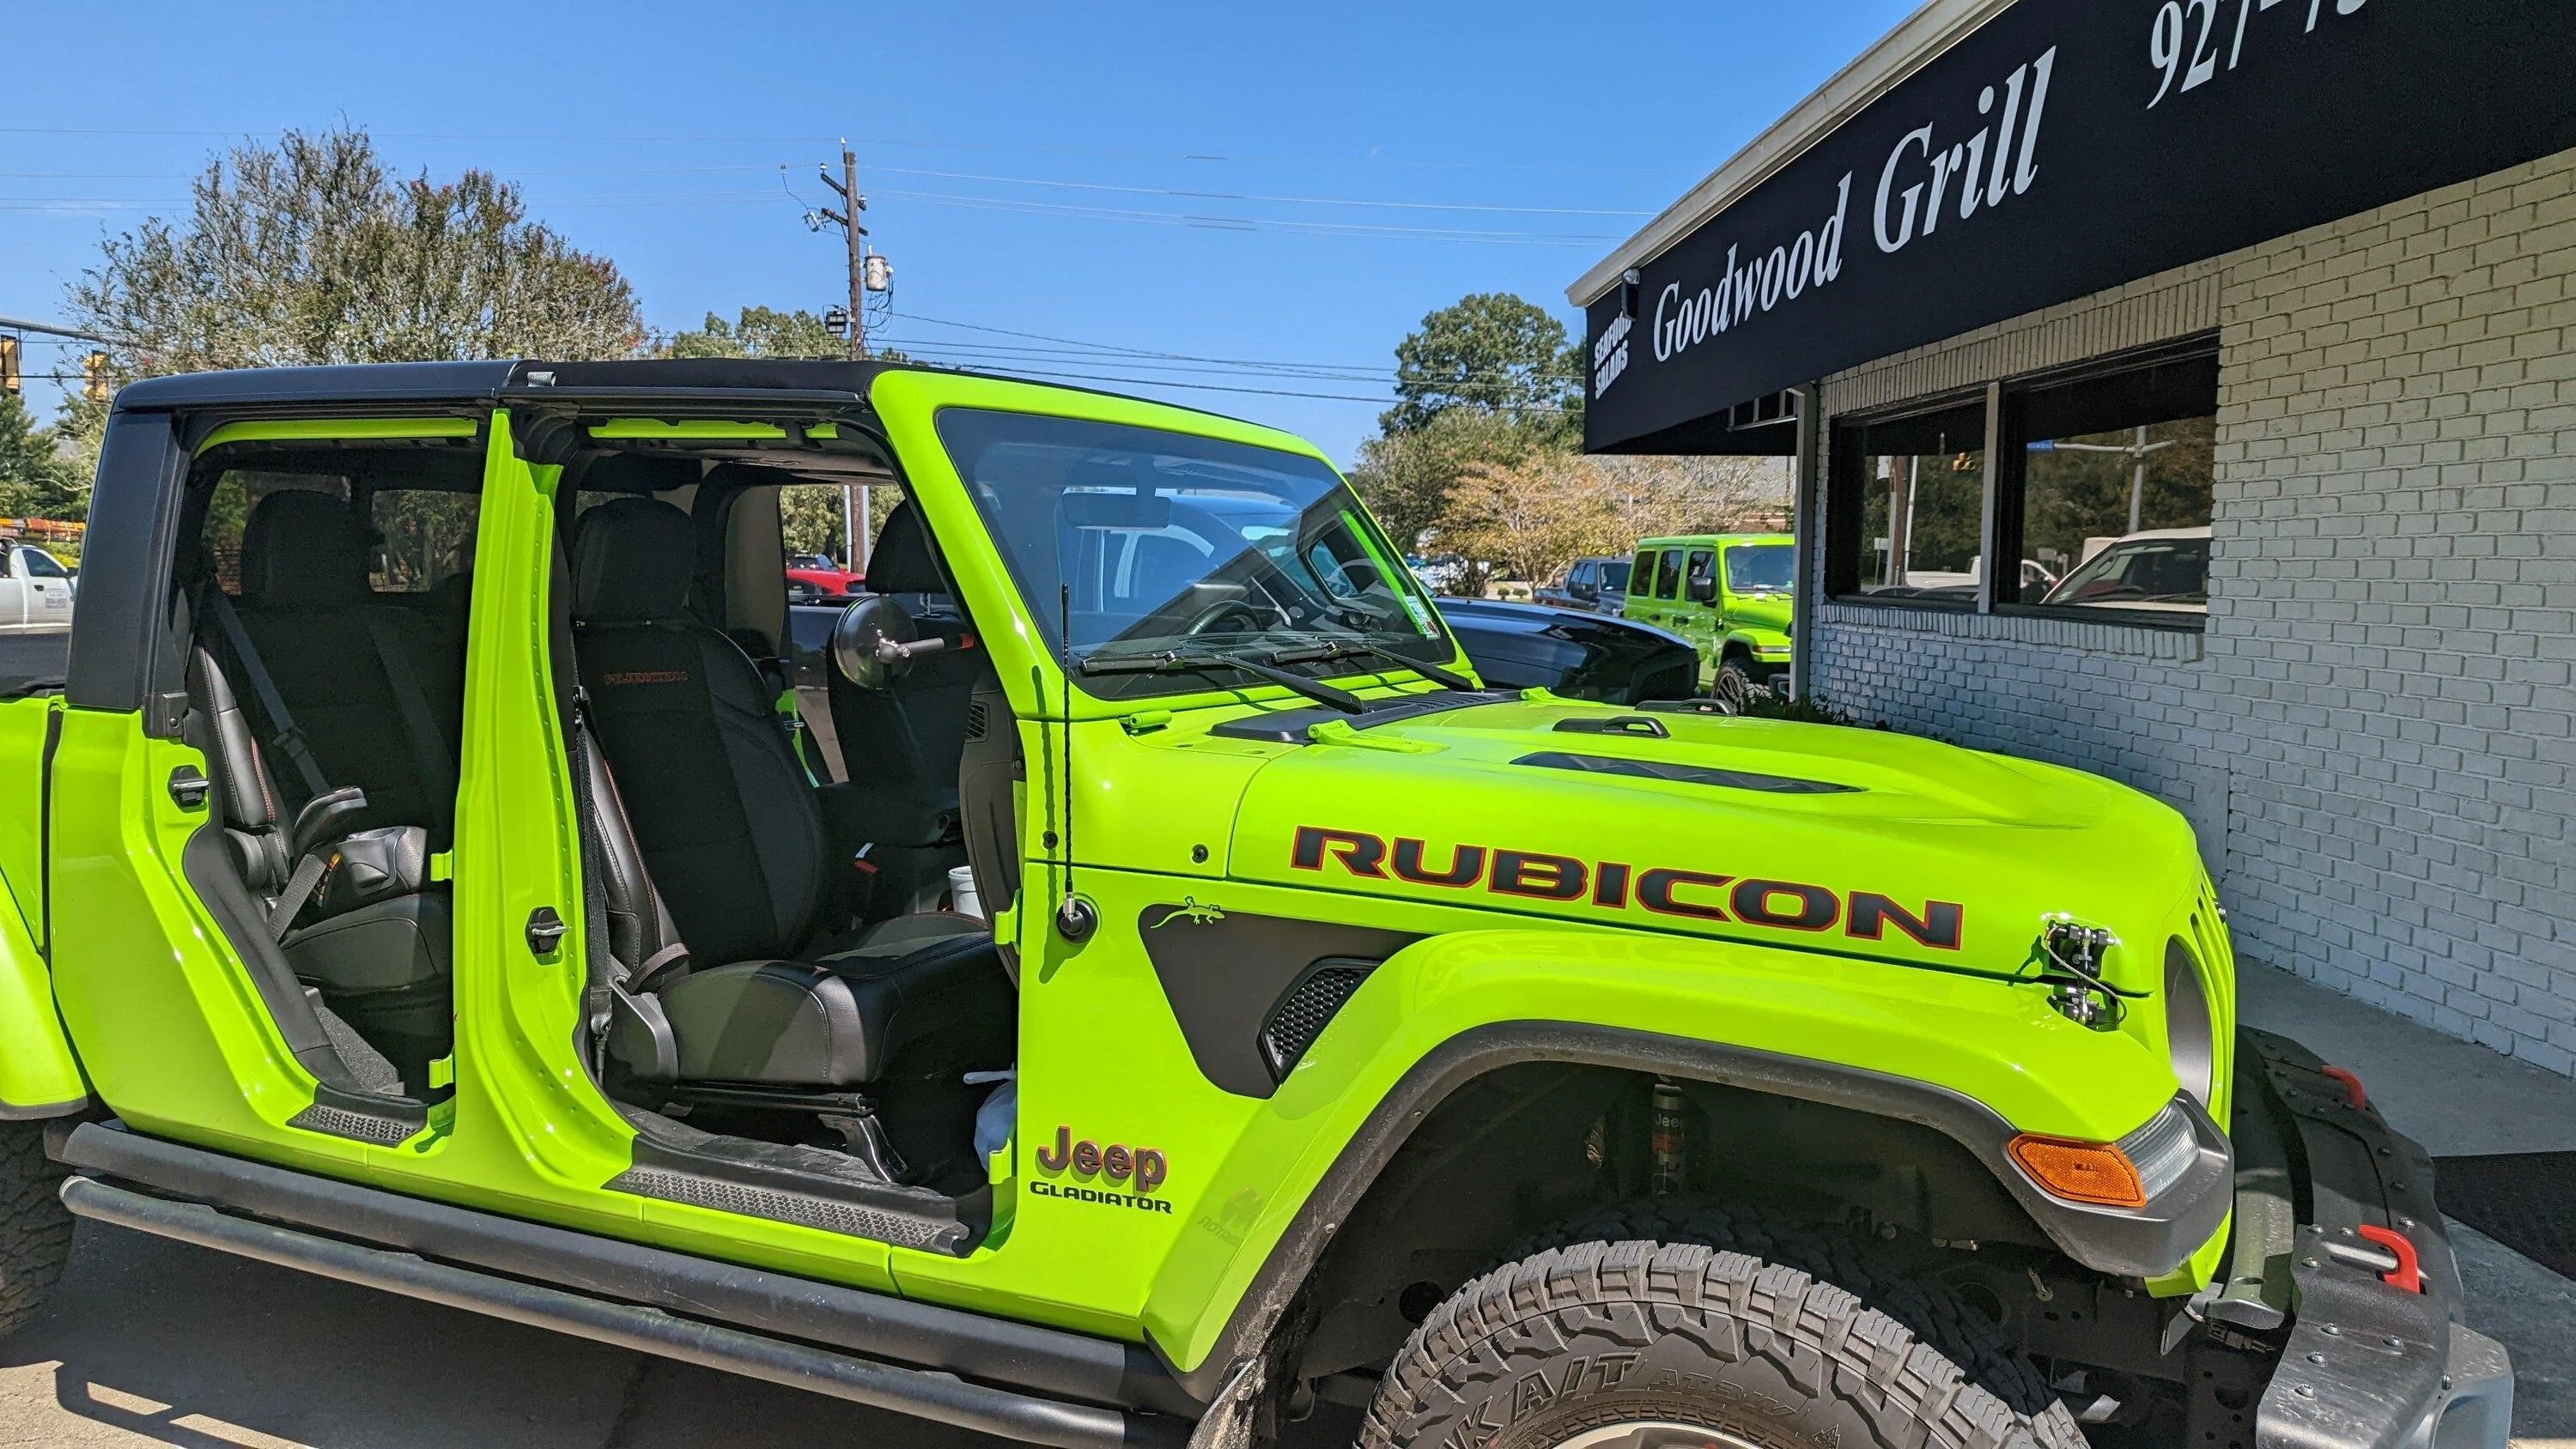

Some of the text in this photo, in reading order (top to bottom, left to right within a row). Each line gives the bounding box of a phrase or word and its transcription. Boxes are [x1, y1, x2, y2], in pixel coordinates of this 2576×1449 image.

[1654, 45, 2057, 361] Goodwood Grill
[1595, 339, 1628, 400] SALADS
[1291, 825, 1964, 951] RUBICON
[1036, 1125, 1168, 1192] Jeep
[1030, 1181, 1173, 1215] GLADIATOR
